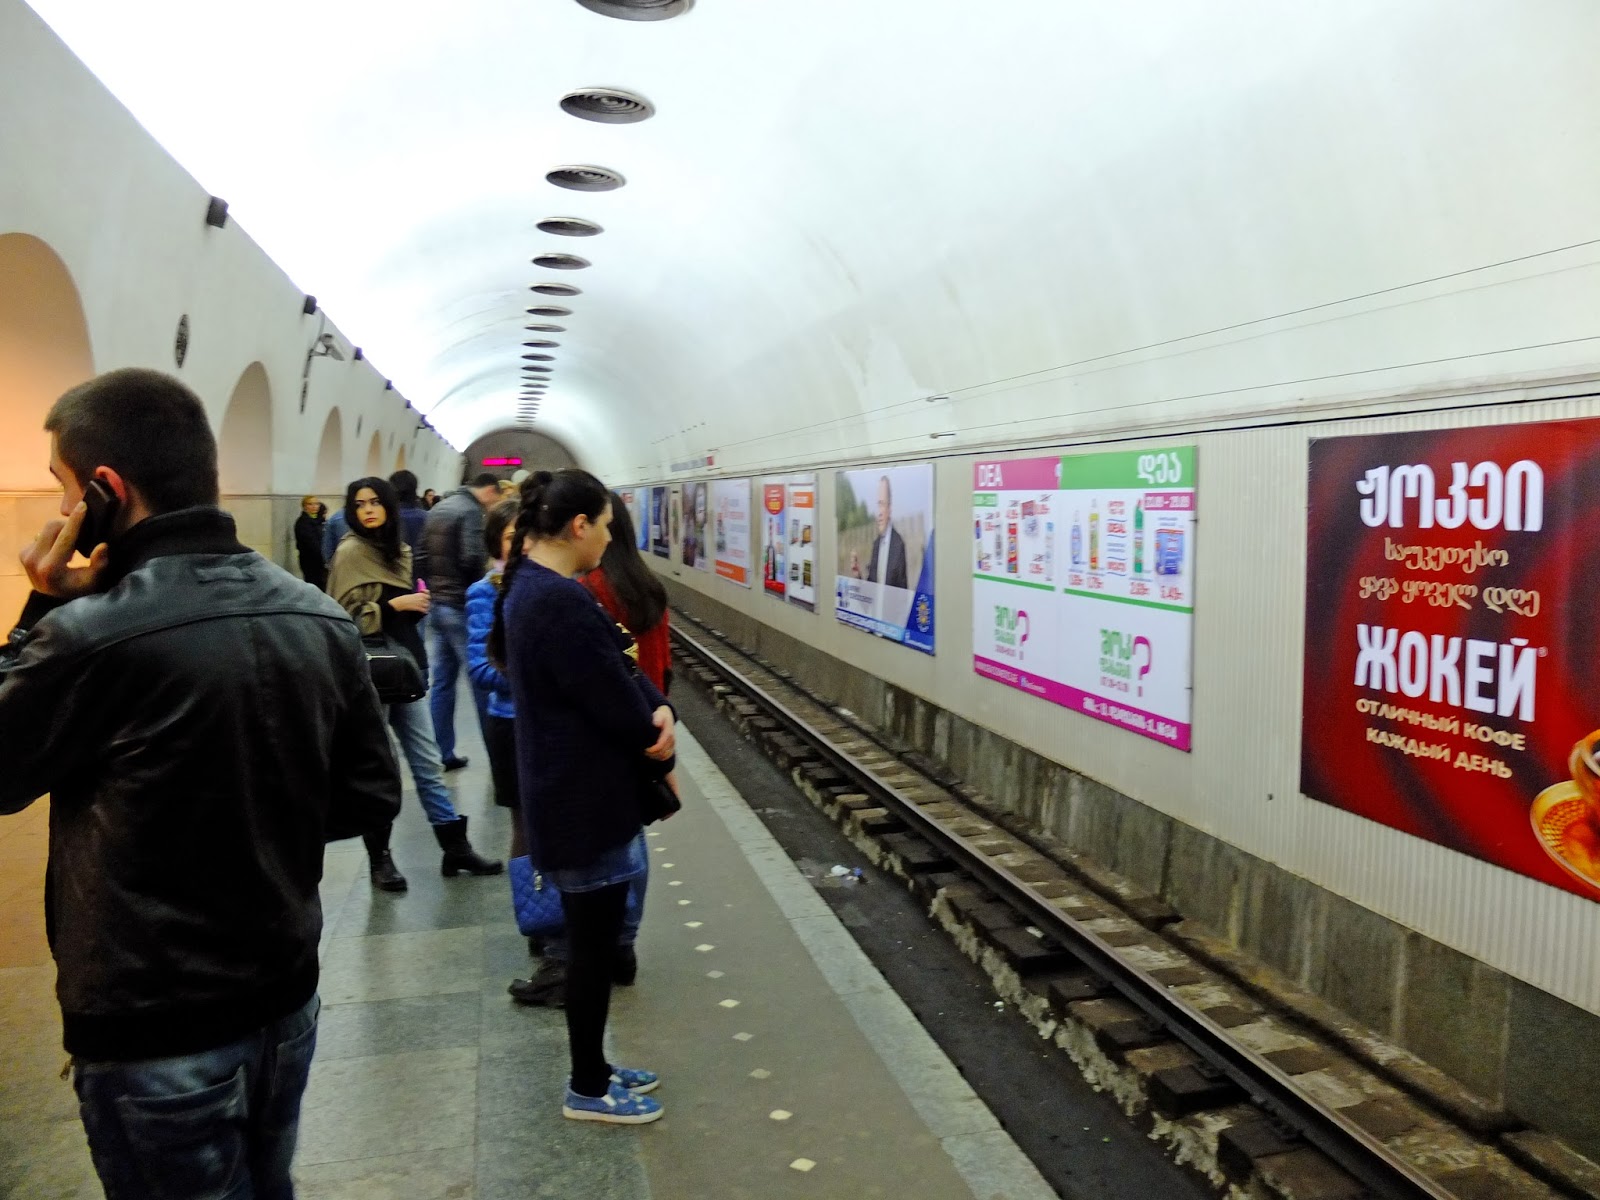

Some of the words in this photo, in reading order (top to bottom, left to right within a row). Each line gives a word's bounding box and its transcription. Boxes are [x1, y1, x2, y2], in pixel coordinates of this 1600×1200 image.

[977, 463, 1004, 488] DEA
[1355, 459, 1544, 532] ჟოკეი
[1384, 536, 1510, 573] საუკეთესო
[1358, 575, 1400, 601] ყავა
[1401, 579, 1479, 611] ყოველ
[1482, 586, 1541, 618] დღე
[1353, 622, 1538, 723] ЖОКЕЙ
[1355, 698, 1460, 735] ОТЛИЧНЫЙ
[1462, 721, 1526, 751] КОФЕ
[1365, 727, 1451, 763] КАЖДЫЙ
[1453, 751, 1513, 779] ДЕНЬ
